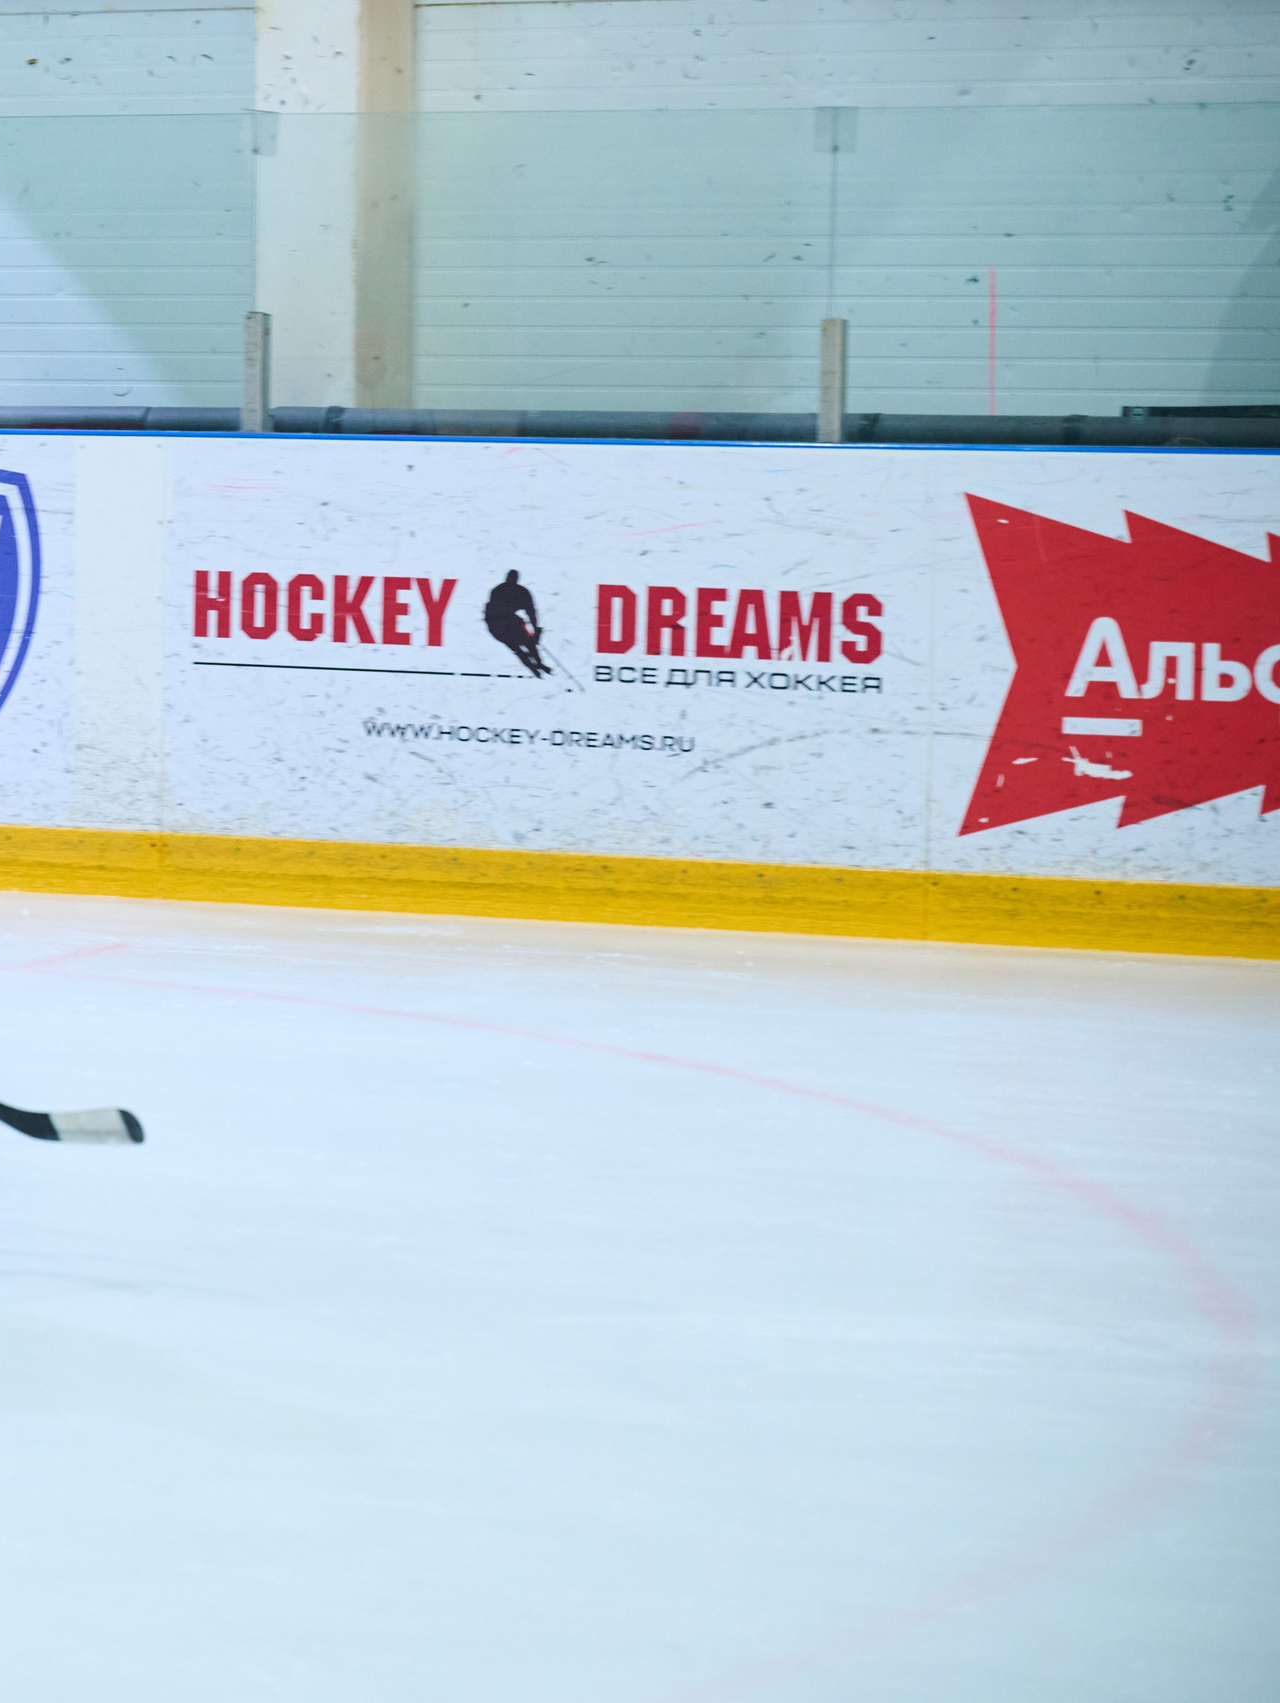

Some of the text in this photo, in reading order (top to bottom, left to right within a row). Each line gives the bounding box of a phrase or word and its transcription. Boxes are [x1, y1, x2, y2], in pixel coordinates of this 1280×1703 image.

[192, 569, 884, 665] HOCKEY DREAMS
[593, 665, 883, 694] ВСЕ ДЛЯ ХОККЕЯ
[362, 720, 696, 753] WWW.HOCKEY-DREAMS.RU
